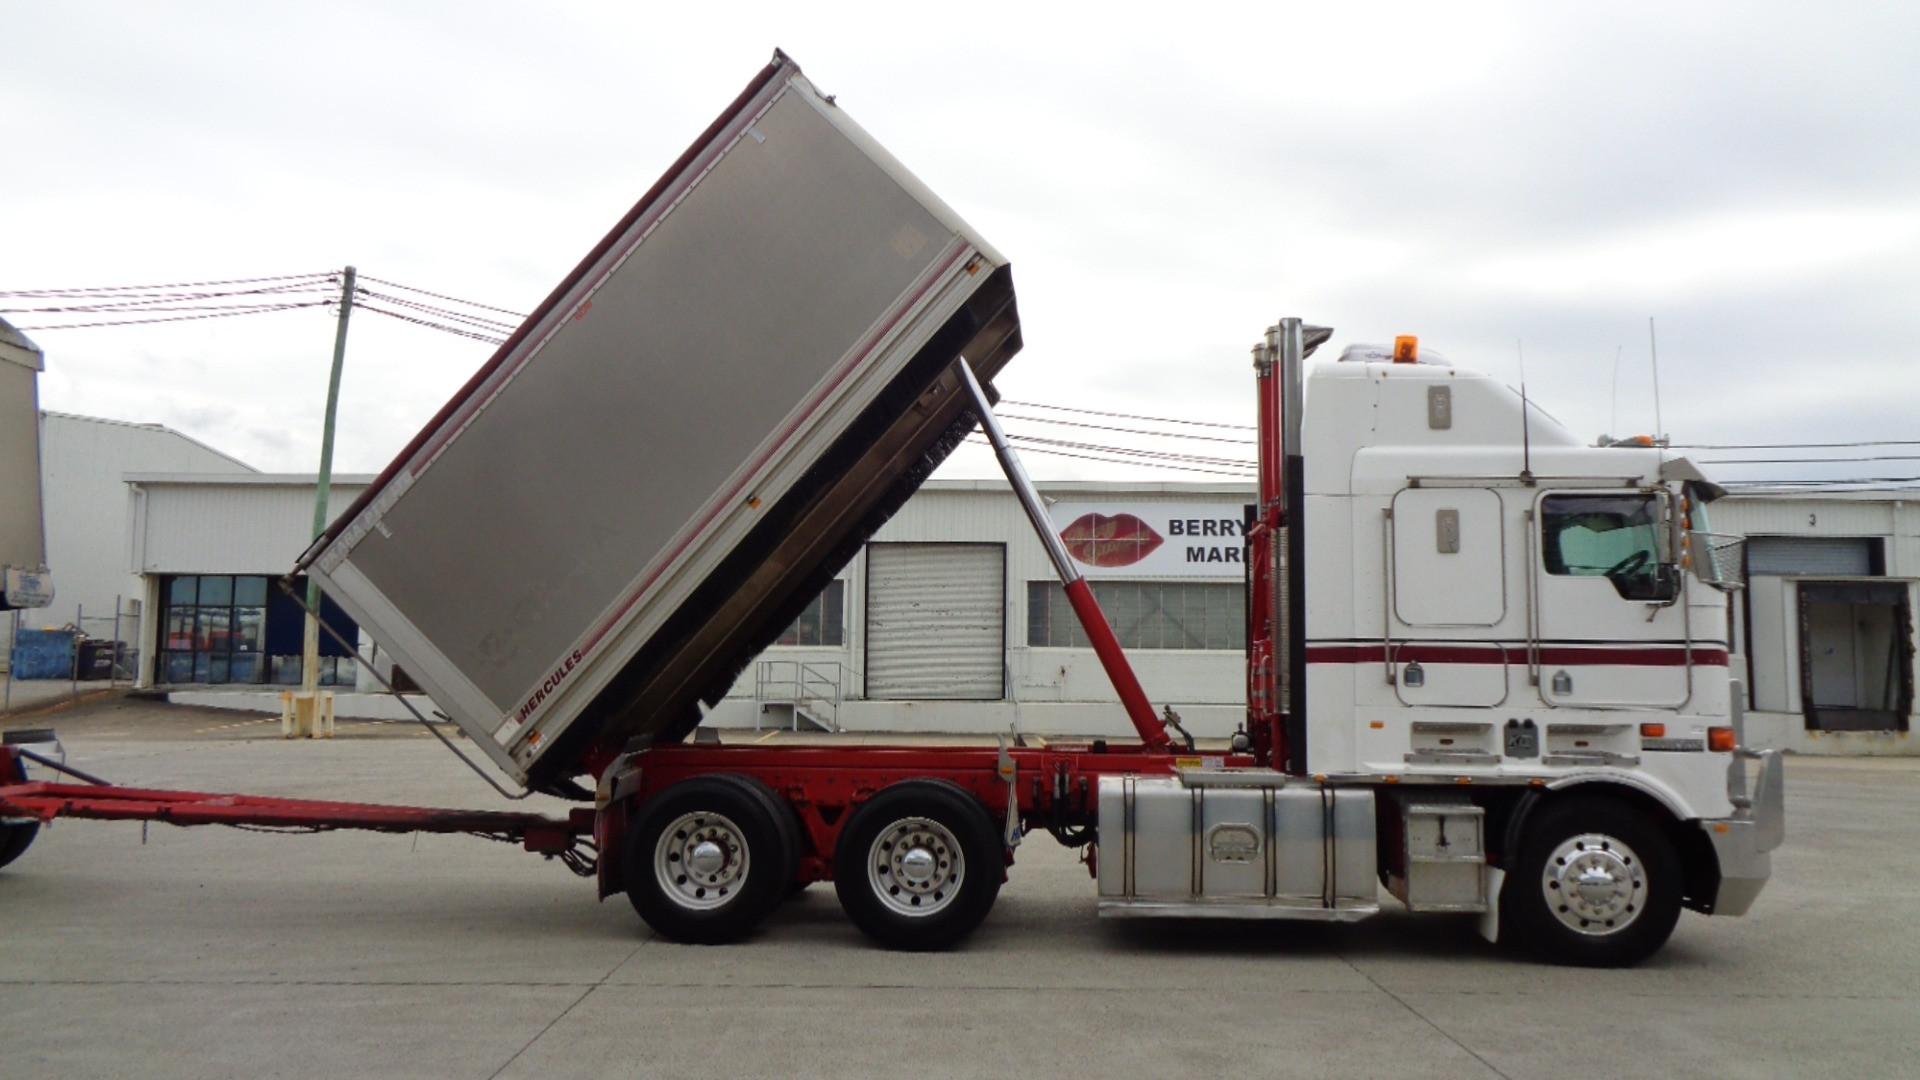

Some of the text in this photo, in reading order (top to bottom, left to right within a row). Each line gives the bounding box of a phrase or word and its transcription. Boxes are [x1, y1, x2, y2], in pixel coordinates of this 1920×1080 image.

[1169, 519, 1246, 536] BERRY
[1186, 546, 1247, 562] MAR
[520, 649, 582, 719] HERCULES
